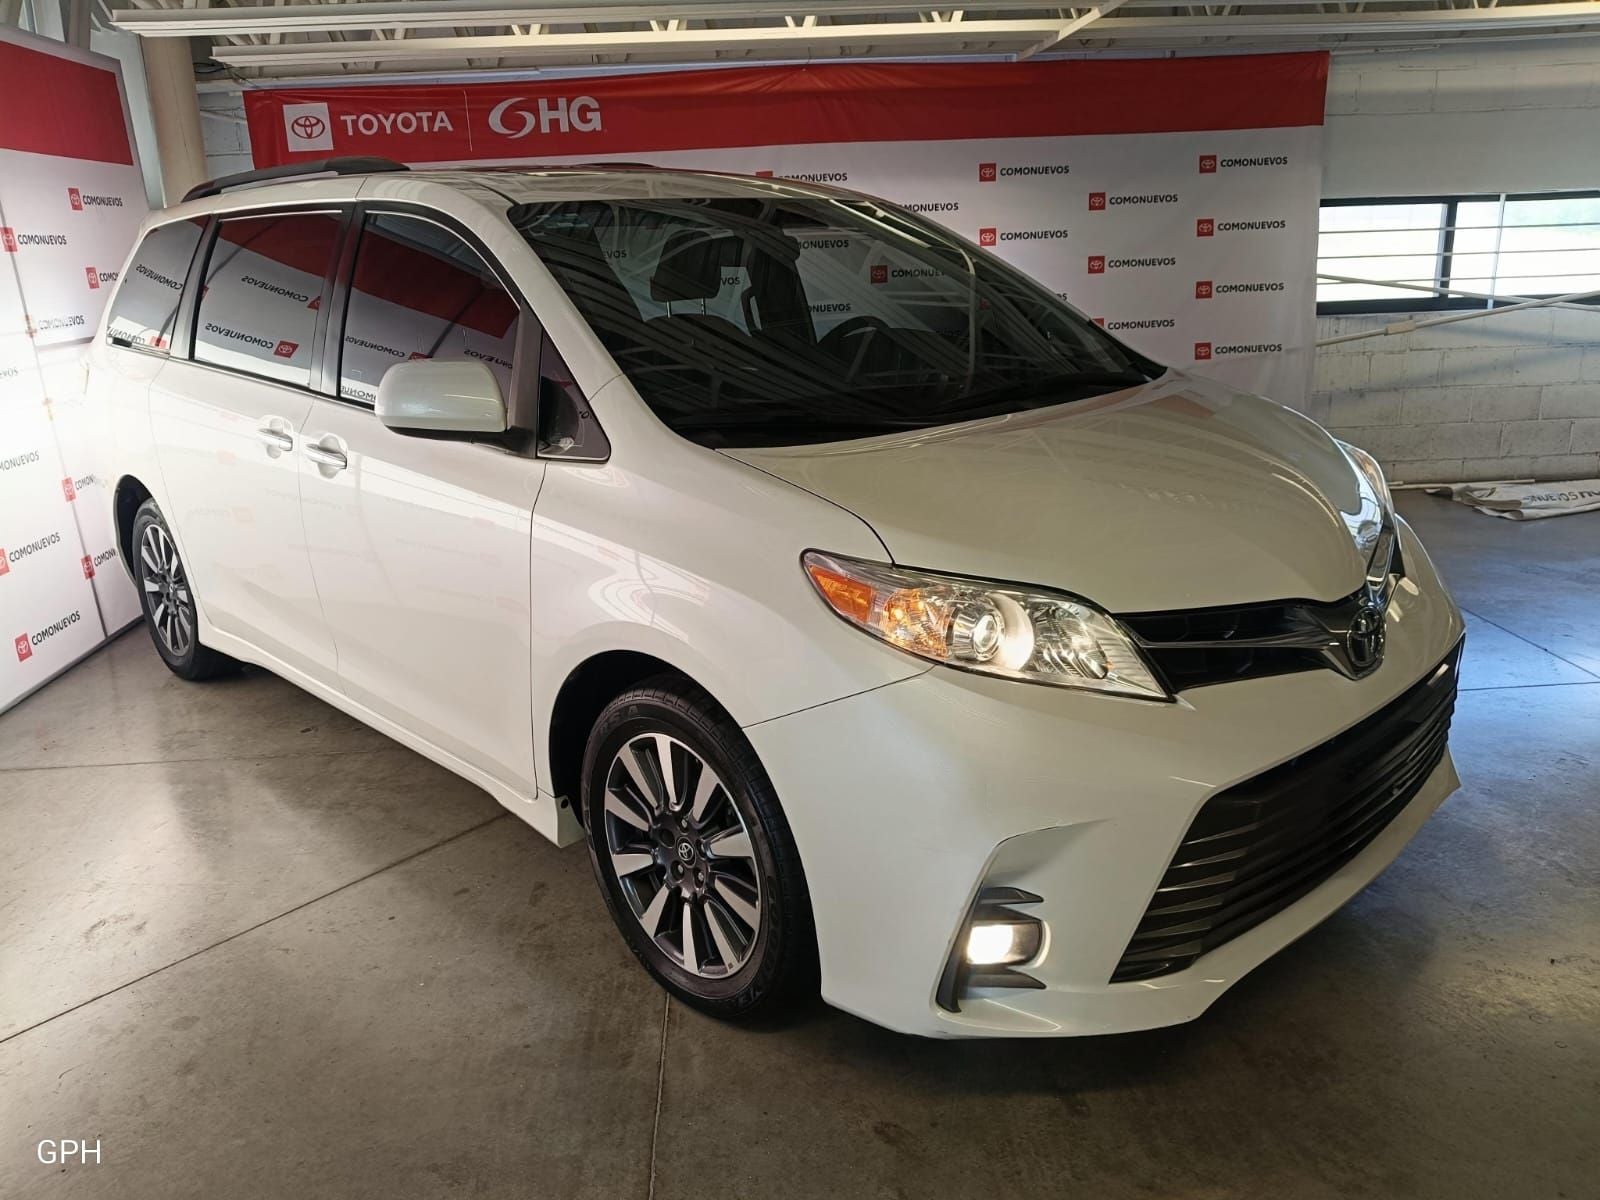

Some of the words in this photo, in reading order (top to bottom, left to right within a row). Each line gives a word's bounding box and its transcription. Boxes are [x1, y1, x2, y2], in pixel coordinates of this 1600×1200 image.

[340, 111, 453, 136] TOYOTA
[539, 96, 602, 133] HG
[1220, 156, 1288, 168] COMONUEVOS
[999, 165, 1070, 177] COMONUEVOS
[779, 172, 848, 184] MONUEVOS
[82, 194, 123, 207] COMONUEVOS
[1108, 193, 1179, 206] COMONUEVOS
[900, 202, 959, 212] MONUEVOS
[1217, 220, 1286, 232] COMONUEVOS
[17, 234, 67, 246] COMONUEVOS
[1000, 229, 1069, 241] COMONUEVOS
[1108, 257, 1176, 269] COMONUEVOS
[1215, 282, 1285, 294] COMONUEVOS
[1107, 319, 1175, 331] COMONUEVOS
[1214, 343, 1283, 355] COMONUEVOS
[8, 531, 61, 563] COMONUEVOS
[31, 610, 81, 646] COMONUEVOS
